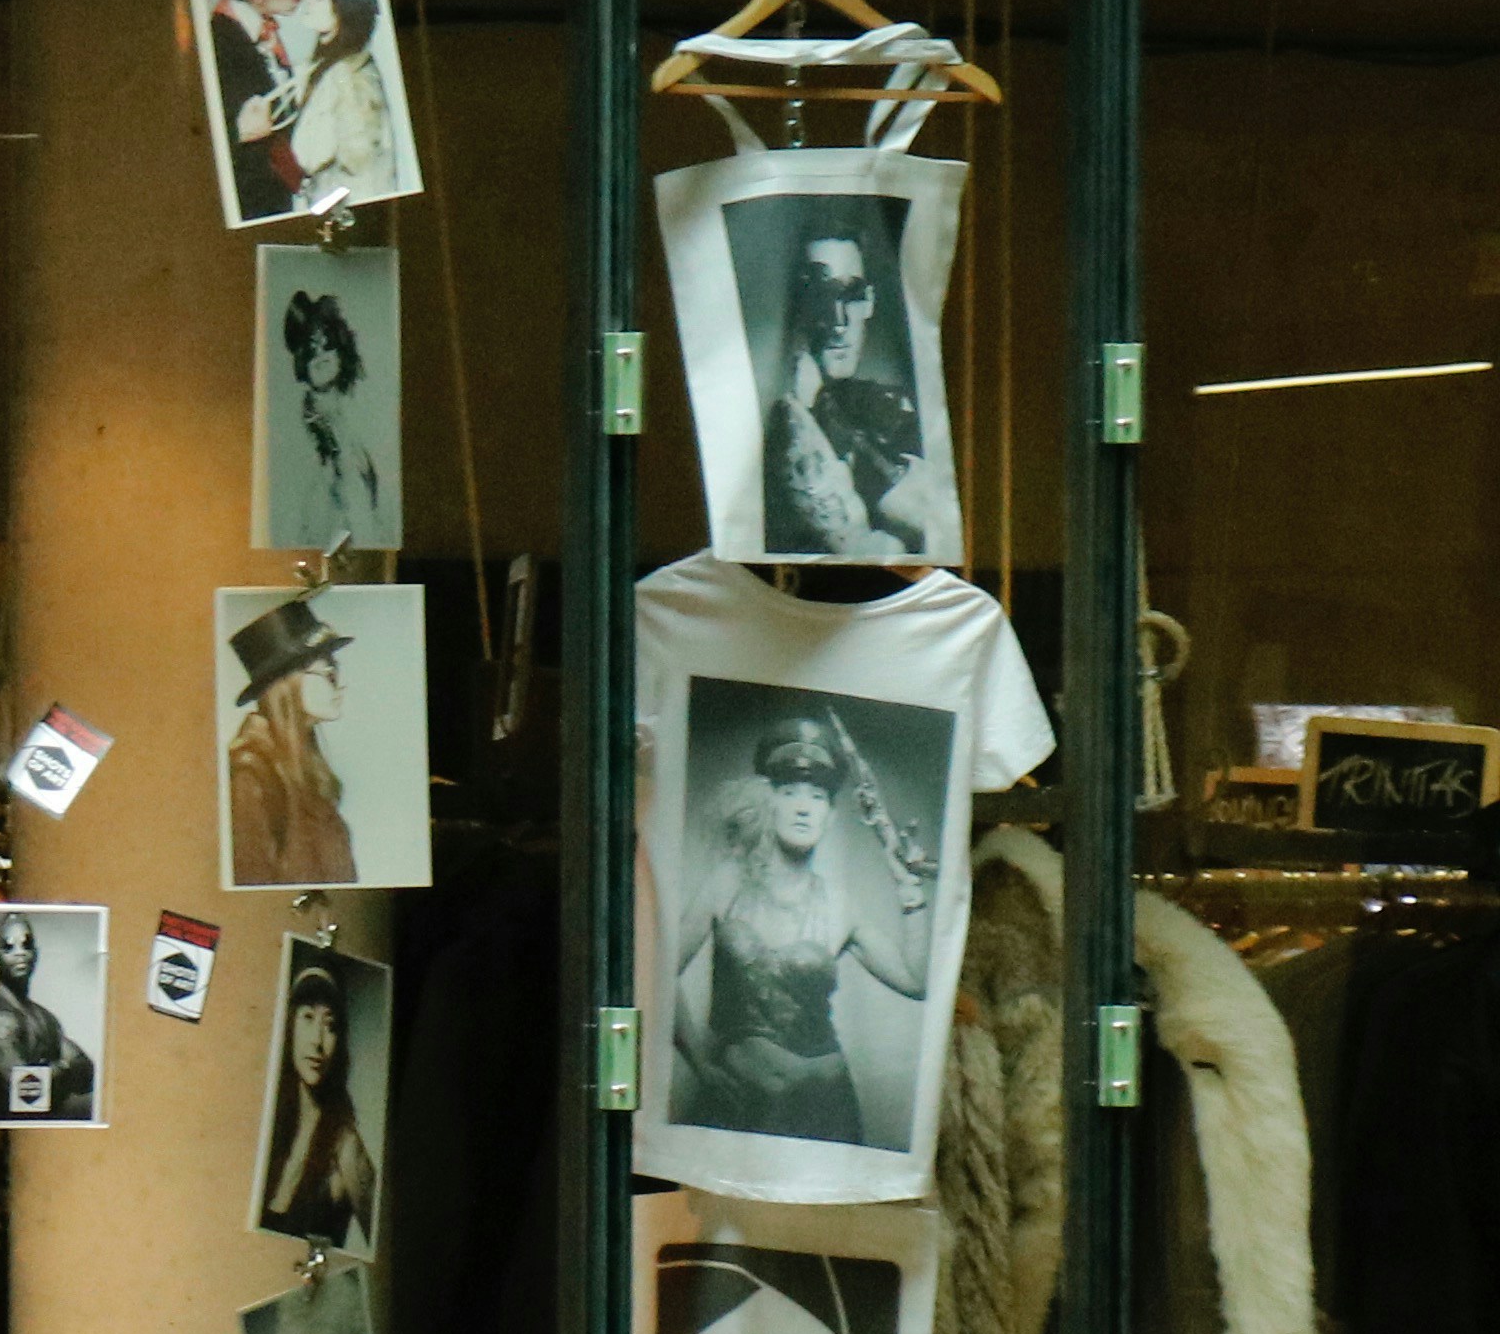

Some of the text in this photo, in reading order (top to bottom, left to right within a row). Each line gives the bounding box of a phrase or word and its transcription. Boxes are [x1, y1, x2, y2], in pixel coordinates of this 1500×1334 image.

[30, 760, 67, 788] OF ART
[36, 749, 71, 778] SHOTS
[158, 972, 196, 992] OF ART
[161, 960, 197, 981] SHOTS
